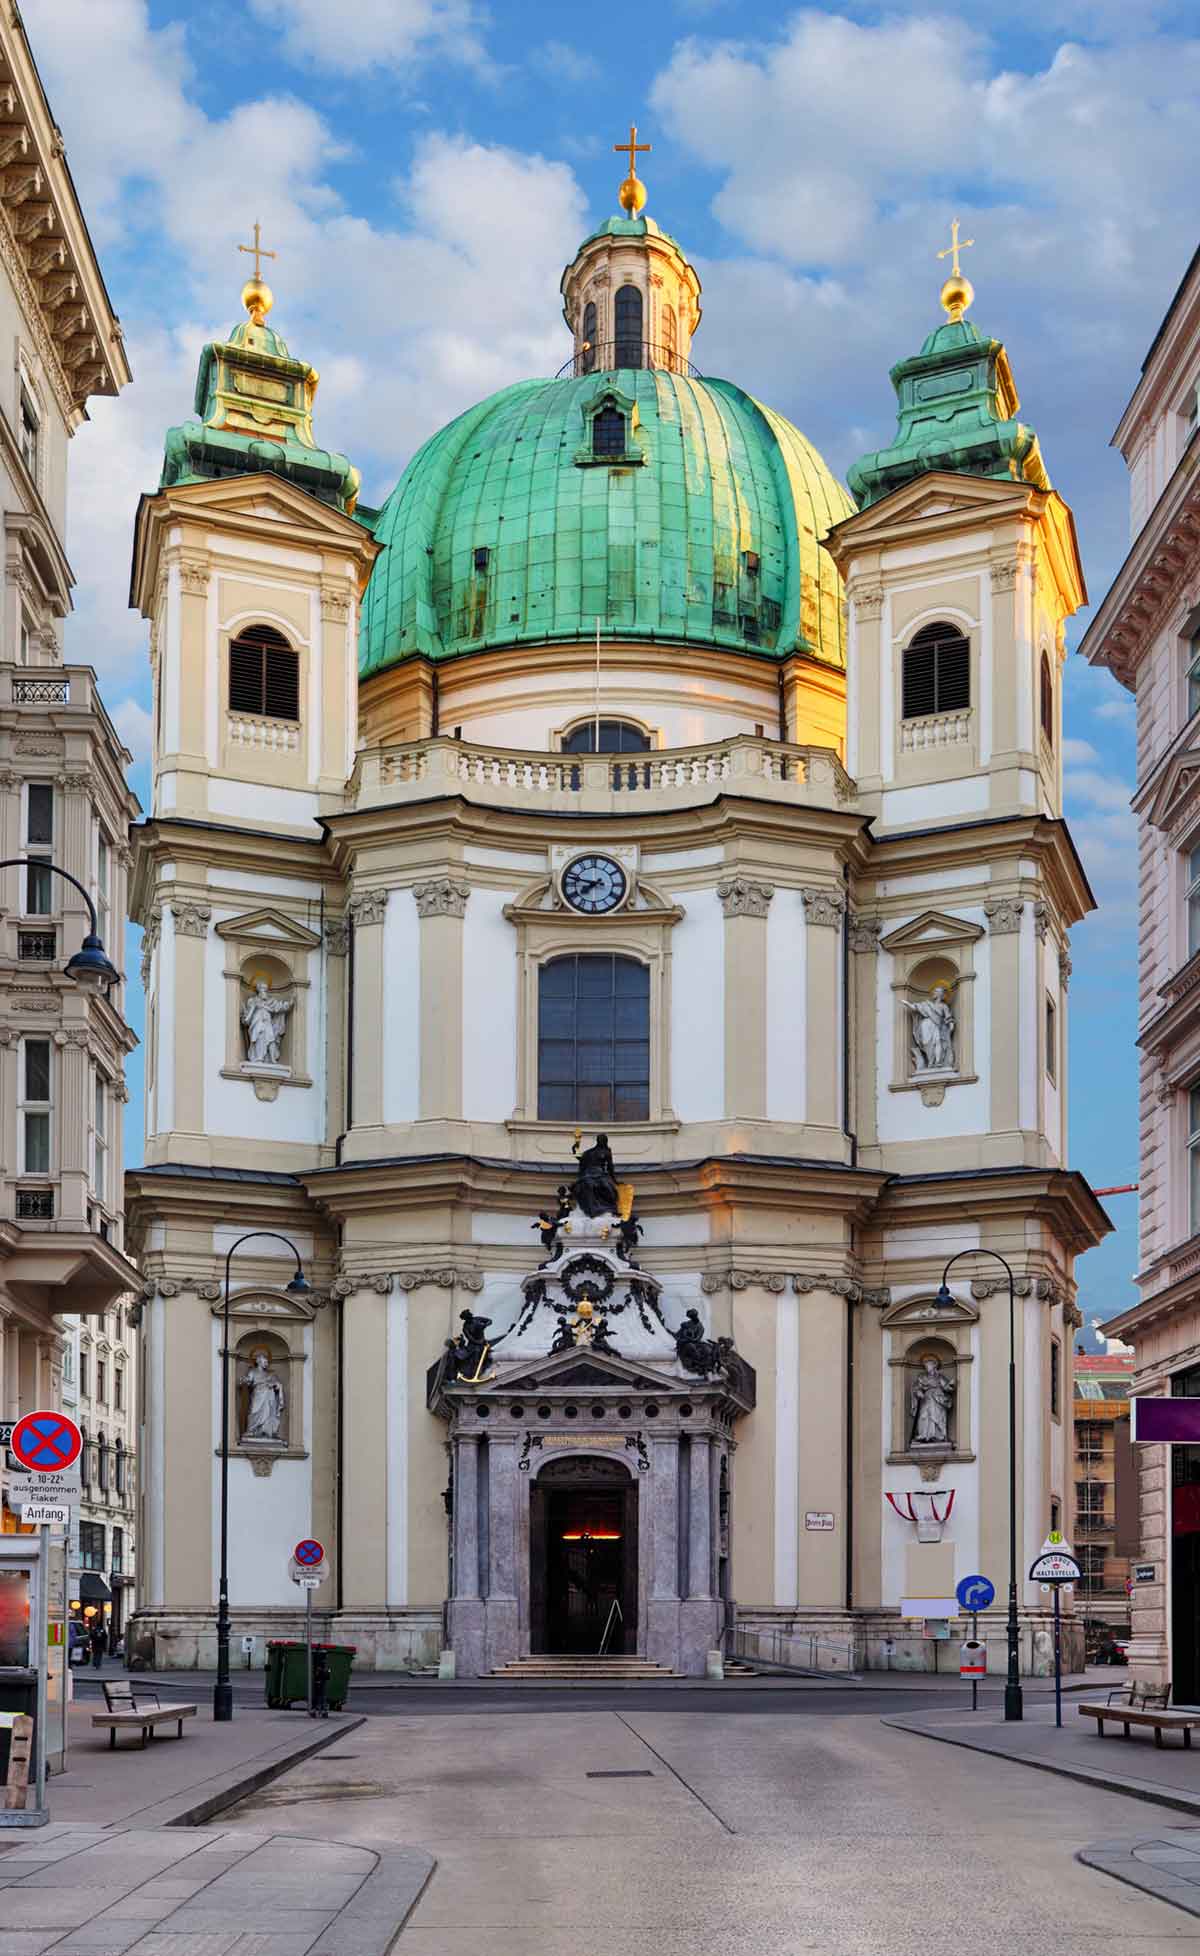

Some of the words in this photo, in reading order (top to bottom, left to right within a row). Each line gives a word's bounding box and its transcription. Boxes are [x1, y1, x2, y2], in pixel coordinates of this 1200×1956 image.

[13, 1484, 78, 1494] ausgenommen
[30, 1494, 58, 1502] Fiaker
[27, 1506, 64, 1521] Anfang
[1042, 1557, 1070, 1566] AUTOBUS
